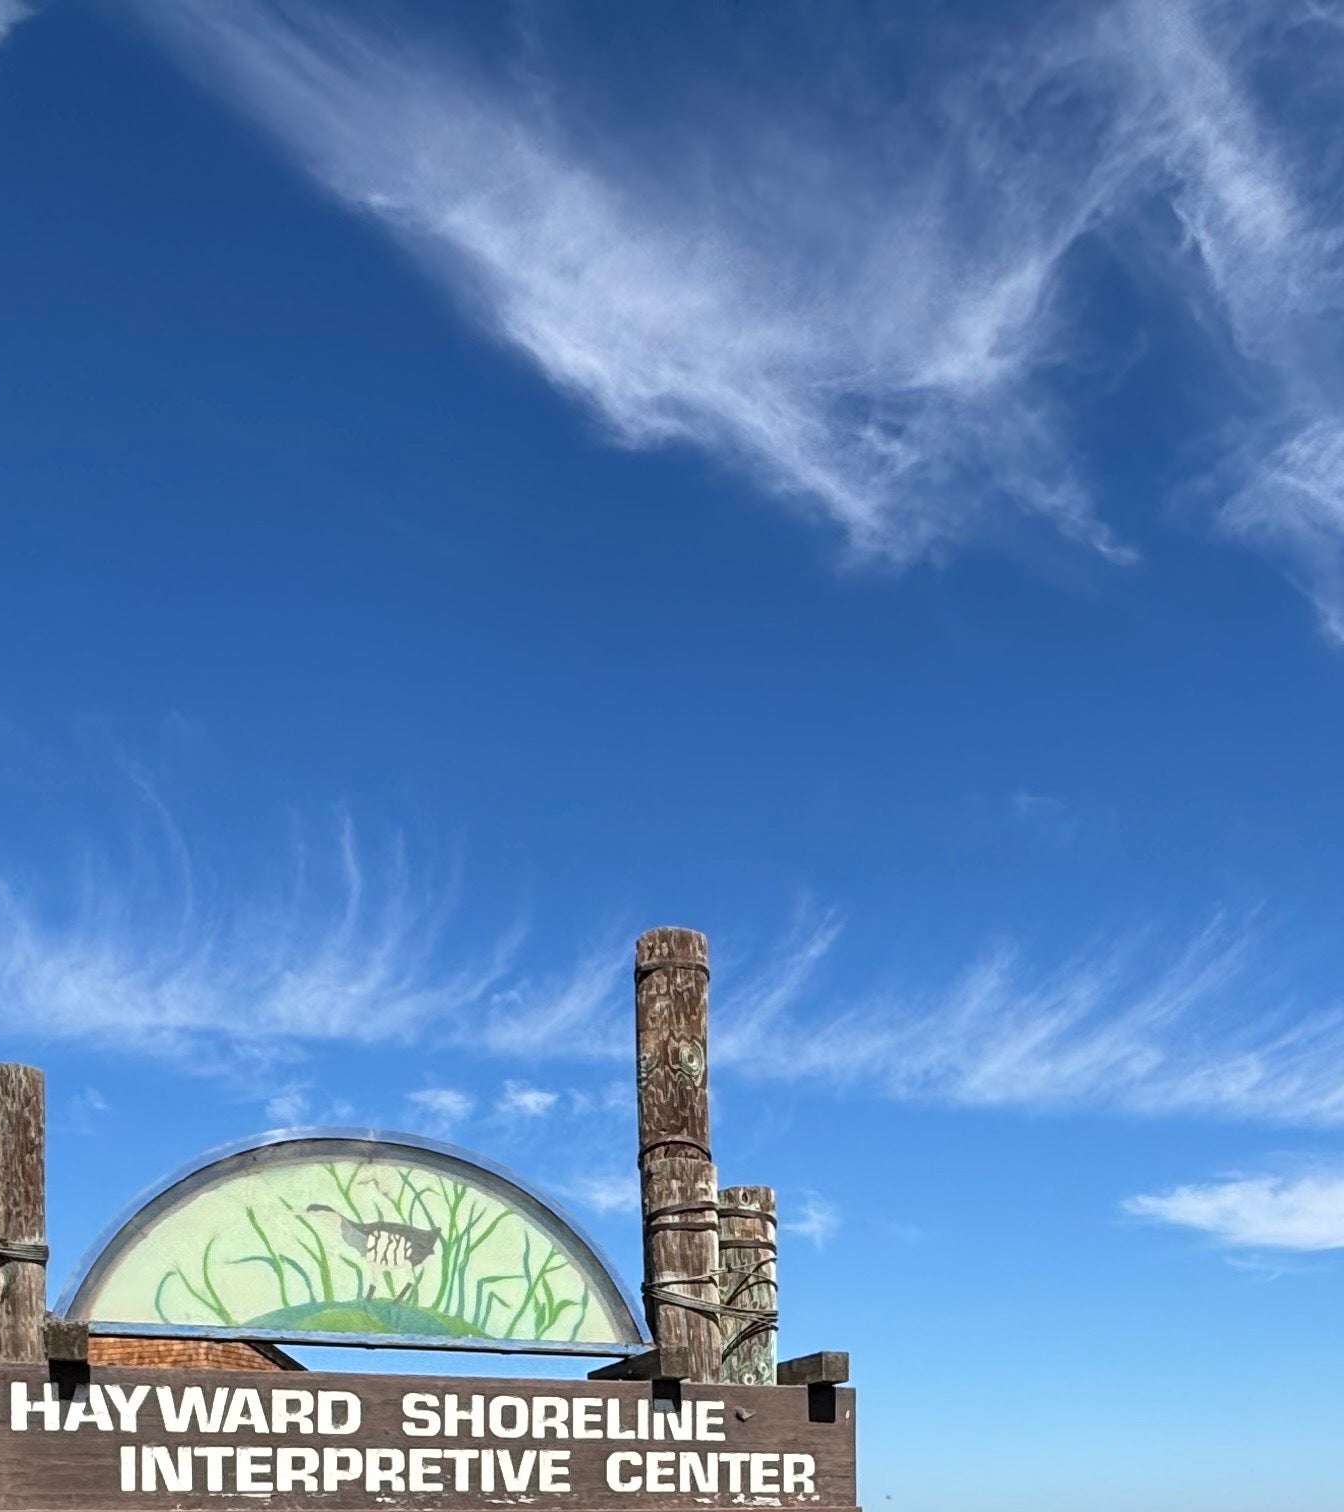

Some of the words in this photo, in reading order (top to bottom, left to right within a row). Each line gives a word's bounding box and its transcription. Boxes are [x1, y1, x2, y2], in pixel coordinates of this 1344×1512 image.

[10, 1381, 362, 1434] HAYWARD
[402, 1393, 726, 1441] SHORELINE
[120, 1445, 571, 1493] INTERPRETIVE
[606, 1451, 816, 1494] CENTER
